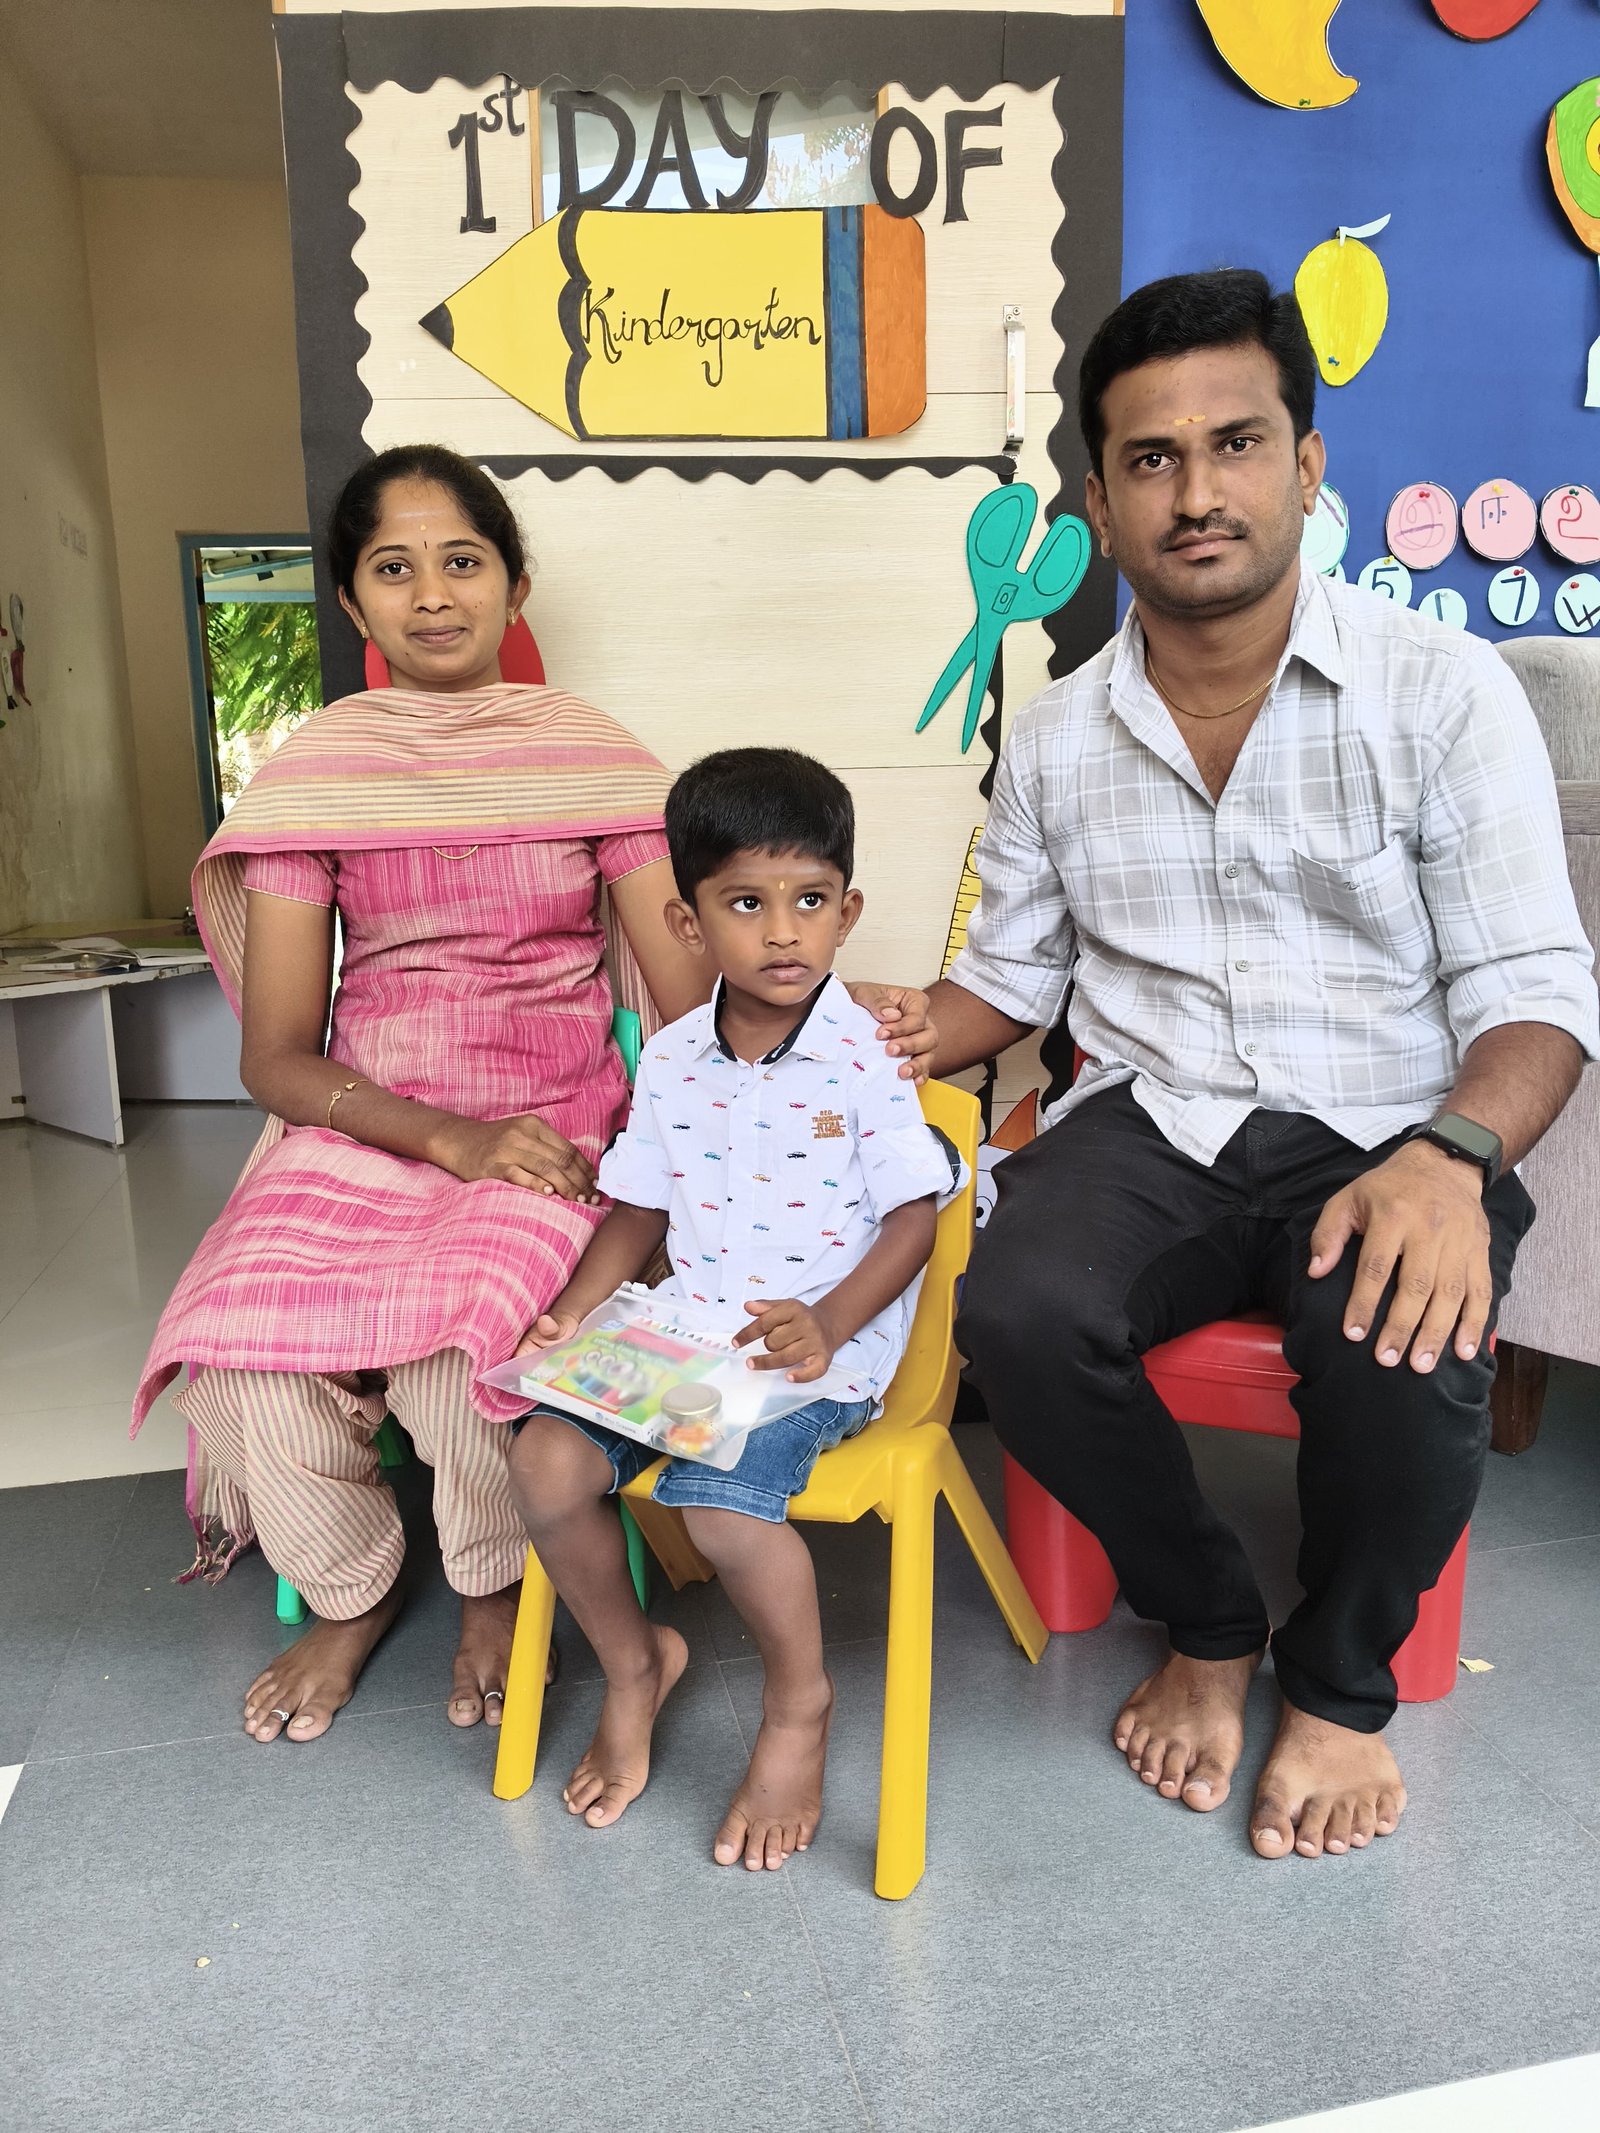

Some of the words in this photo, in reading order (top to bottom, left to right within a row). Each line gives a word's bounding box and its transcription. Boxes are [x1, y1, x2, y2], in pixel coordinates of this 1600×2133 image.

[550, 90, 780, 210] DAY
[870, 102, 1005, 224] OF
[580, 287, 822, 387] Kindergarten
[1500, 575, 1527, 623] 7
